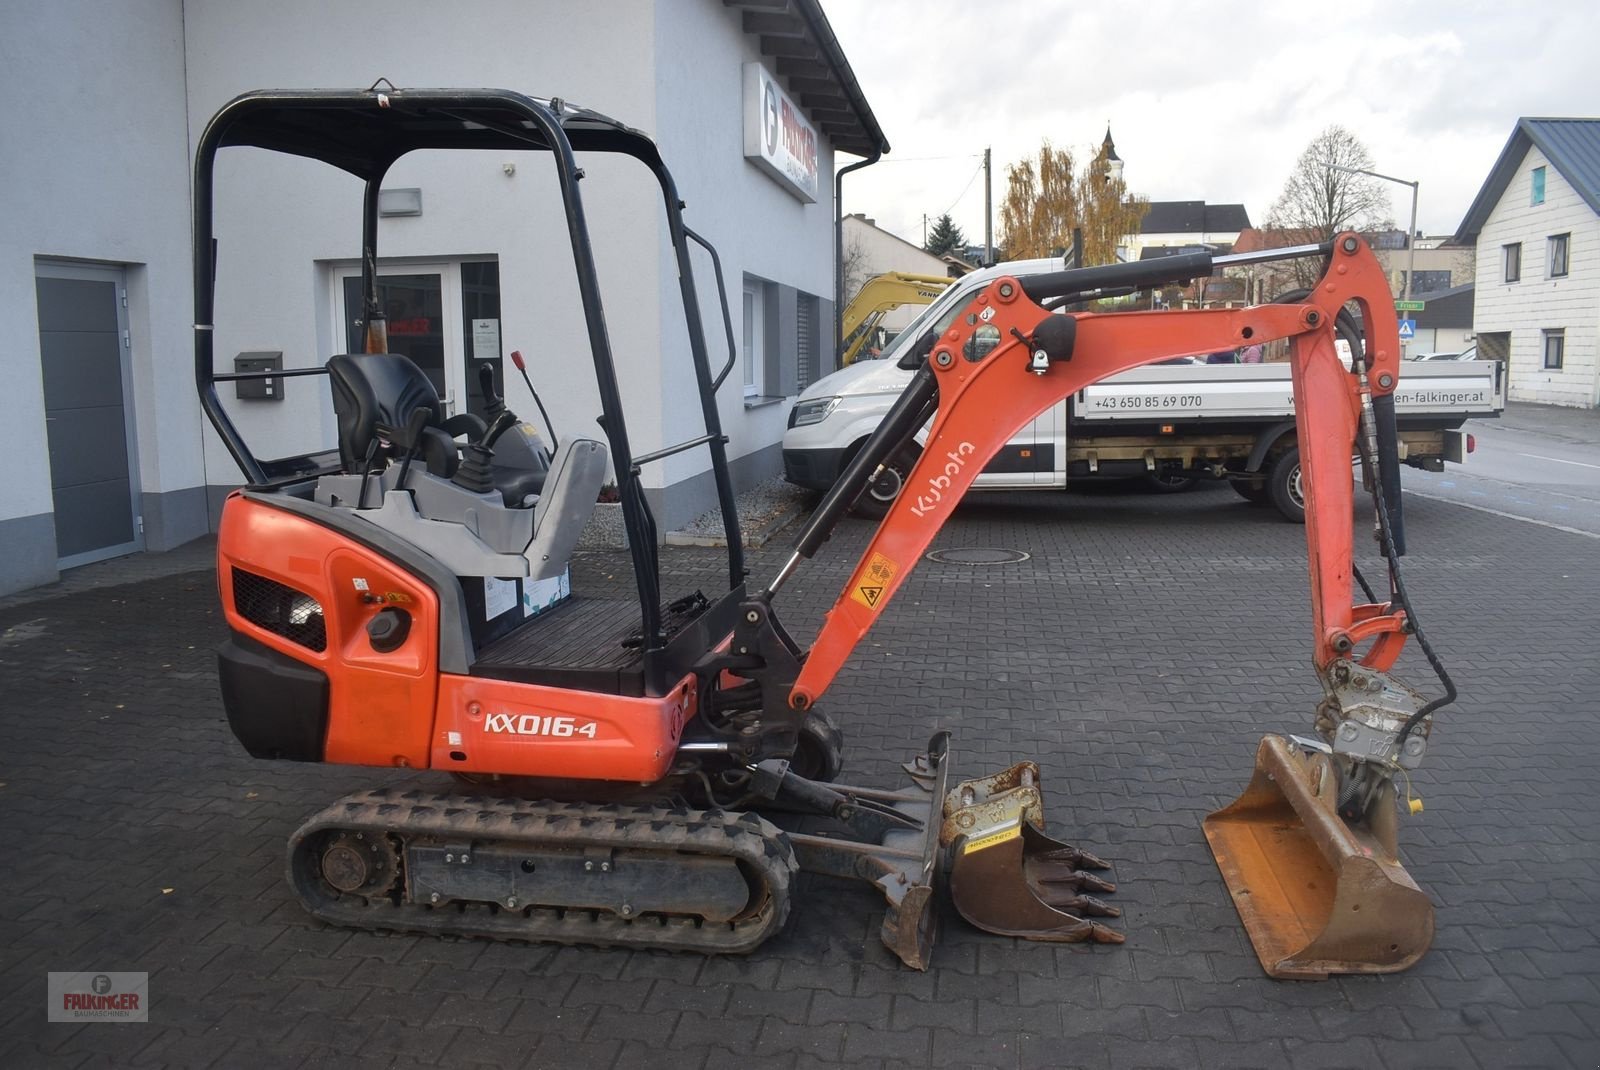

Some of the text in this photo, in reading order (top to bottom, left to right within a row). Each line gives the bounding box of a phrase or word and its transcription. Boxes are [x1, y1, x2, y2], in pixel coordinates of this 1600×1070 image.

[918, 290, 940, 298] YANM
[1095, 395, 1202, 408] +43 650 85 69 070
[910, 441, 976, 517] Kubota
